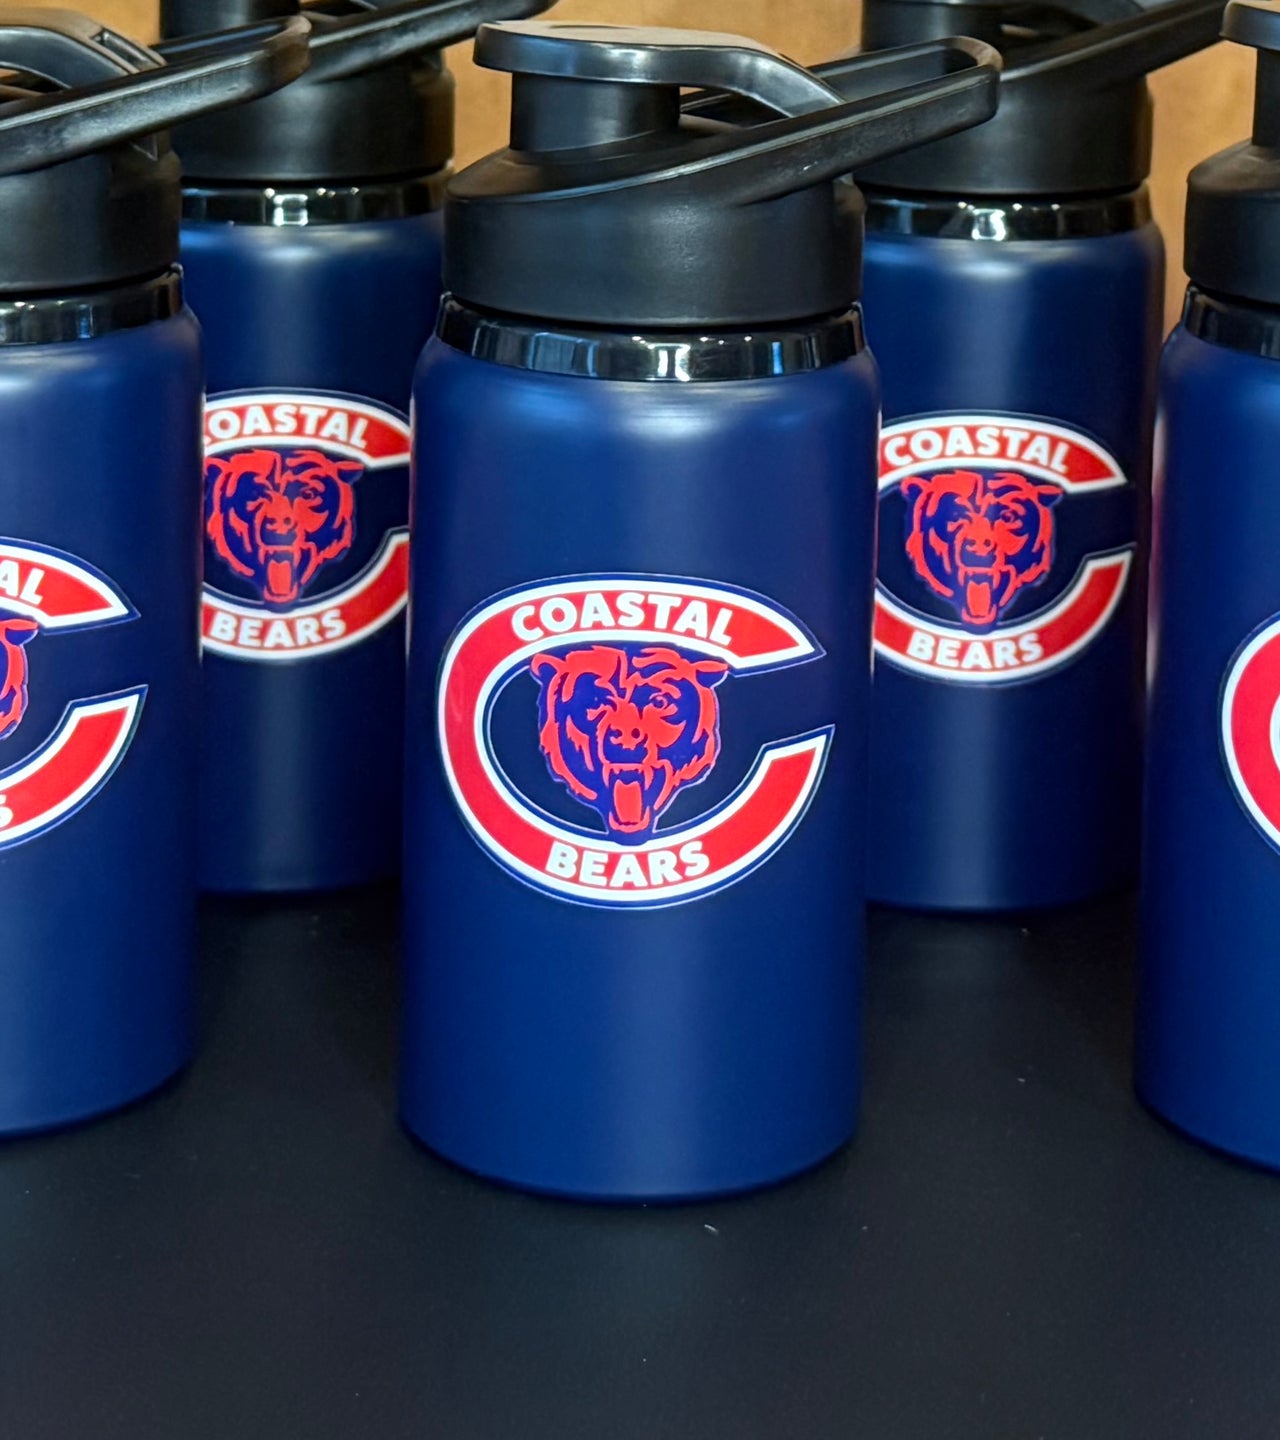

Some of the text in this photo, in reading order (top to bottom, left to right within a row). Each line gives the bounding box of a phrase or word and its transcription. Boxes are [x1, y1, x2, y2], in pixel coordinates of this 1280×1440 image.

[204, 403, 369, 449] OASTAL
[884, 426, 1070, 473] COASTAL
[210, 609, 347, 648] BEARS
[512, 591, 733, 647] COASTAL
[906, 631, 1043, 670] BEARS
[545, 840, 711, 888] BEARS
